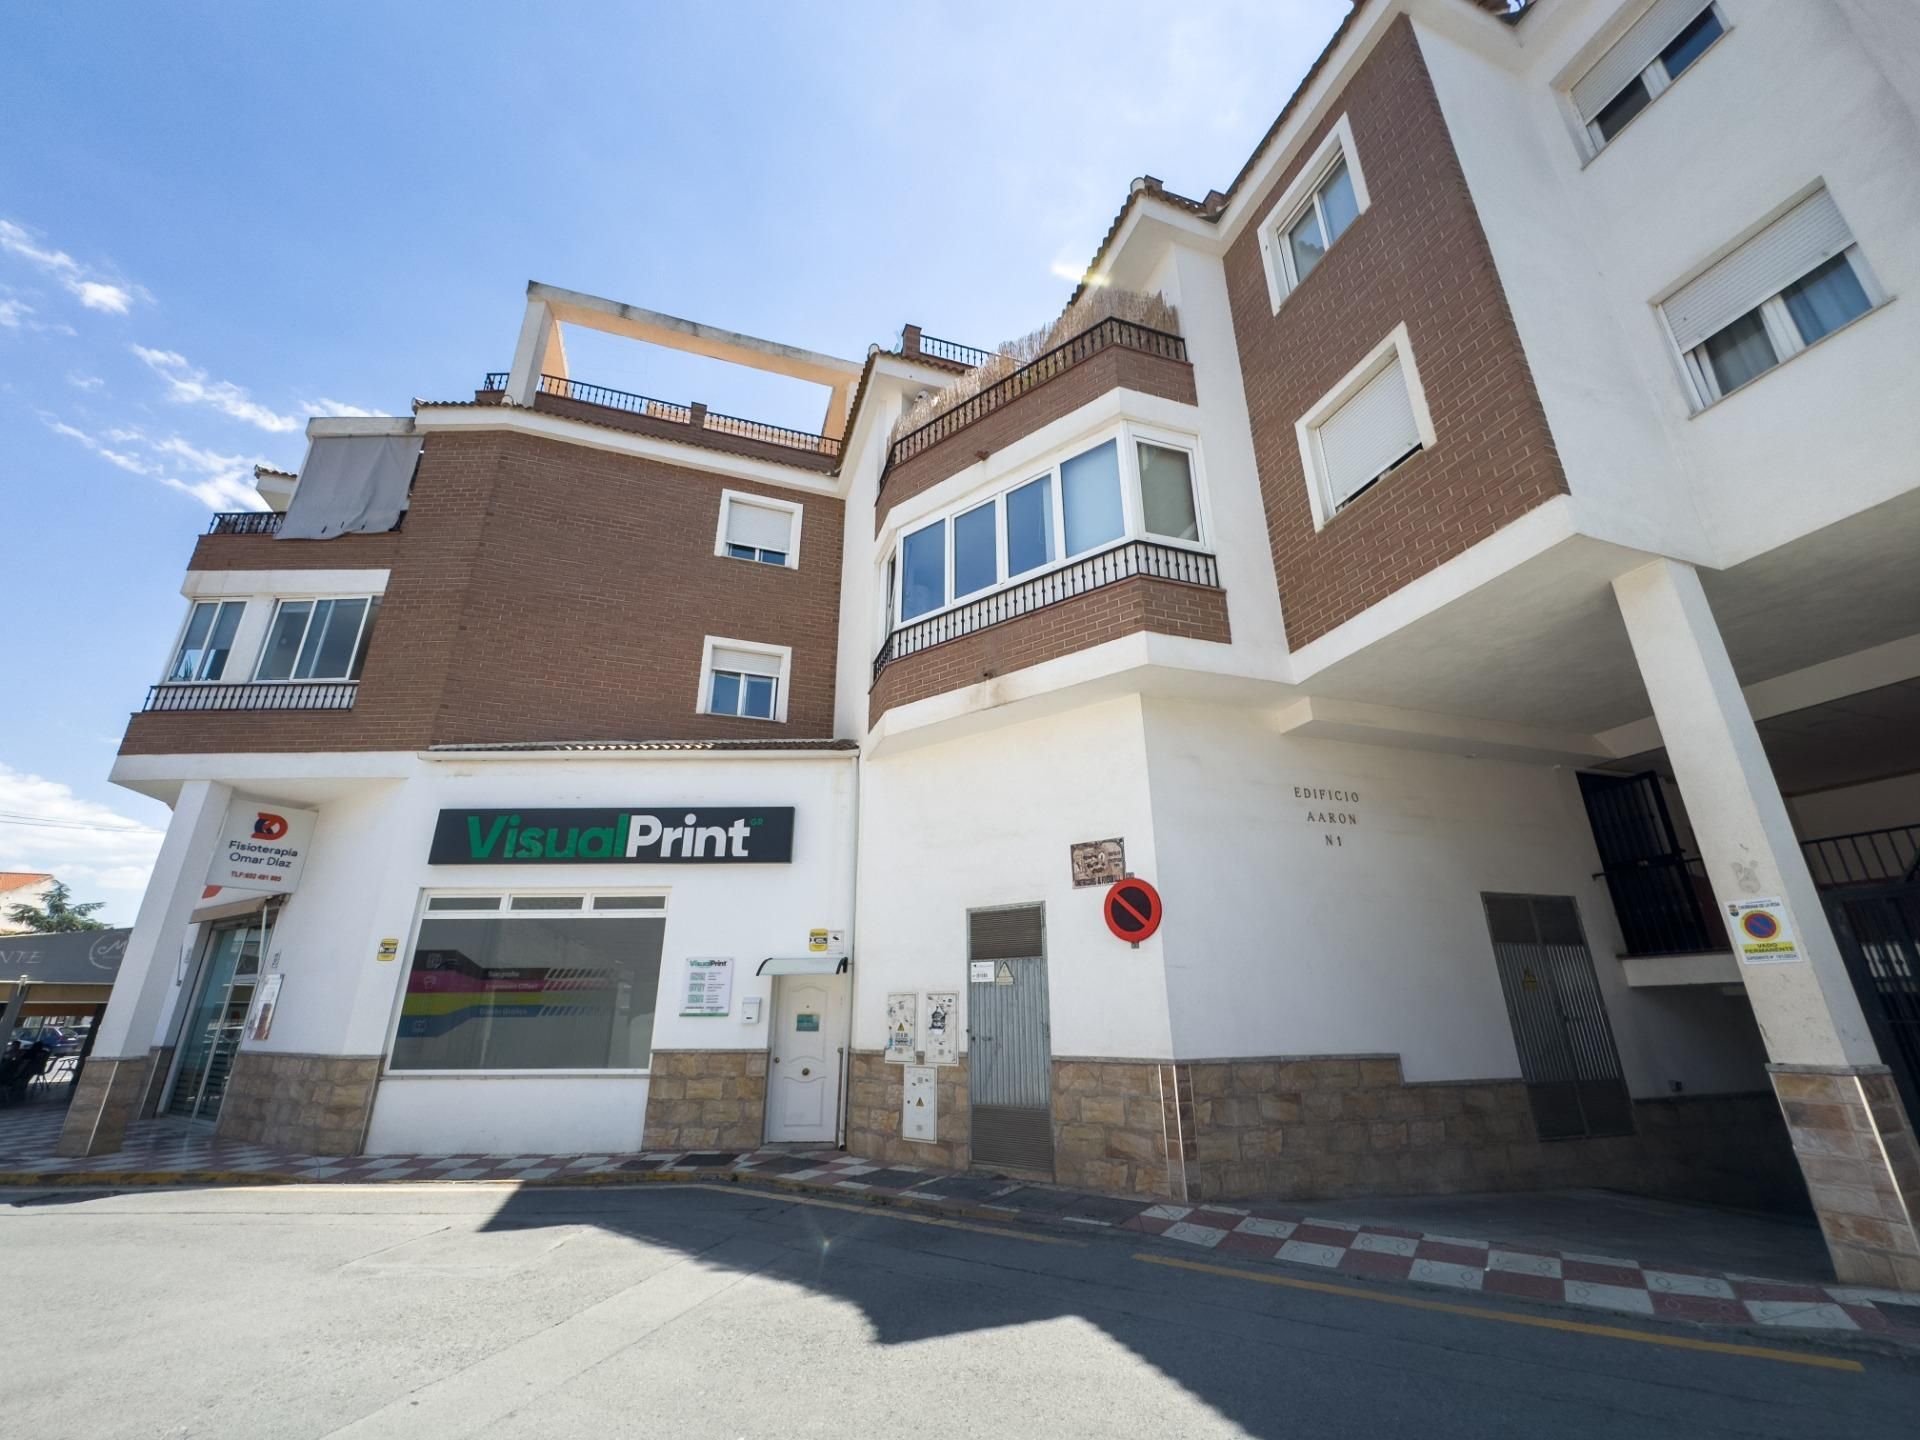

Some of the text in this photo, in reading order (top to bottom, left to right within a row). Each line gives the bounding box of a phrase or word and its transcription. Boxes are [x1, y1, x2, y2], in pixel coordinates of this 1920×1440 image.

[1294, 787, 1360, 803] EDIFICIO
[1307, 811, 1357, 825] AARON
[467, 813, 749, 858] VisualPrint
[229, 852, 264, 864] Omar
